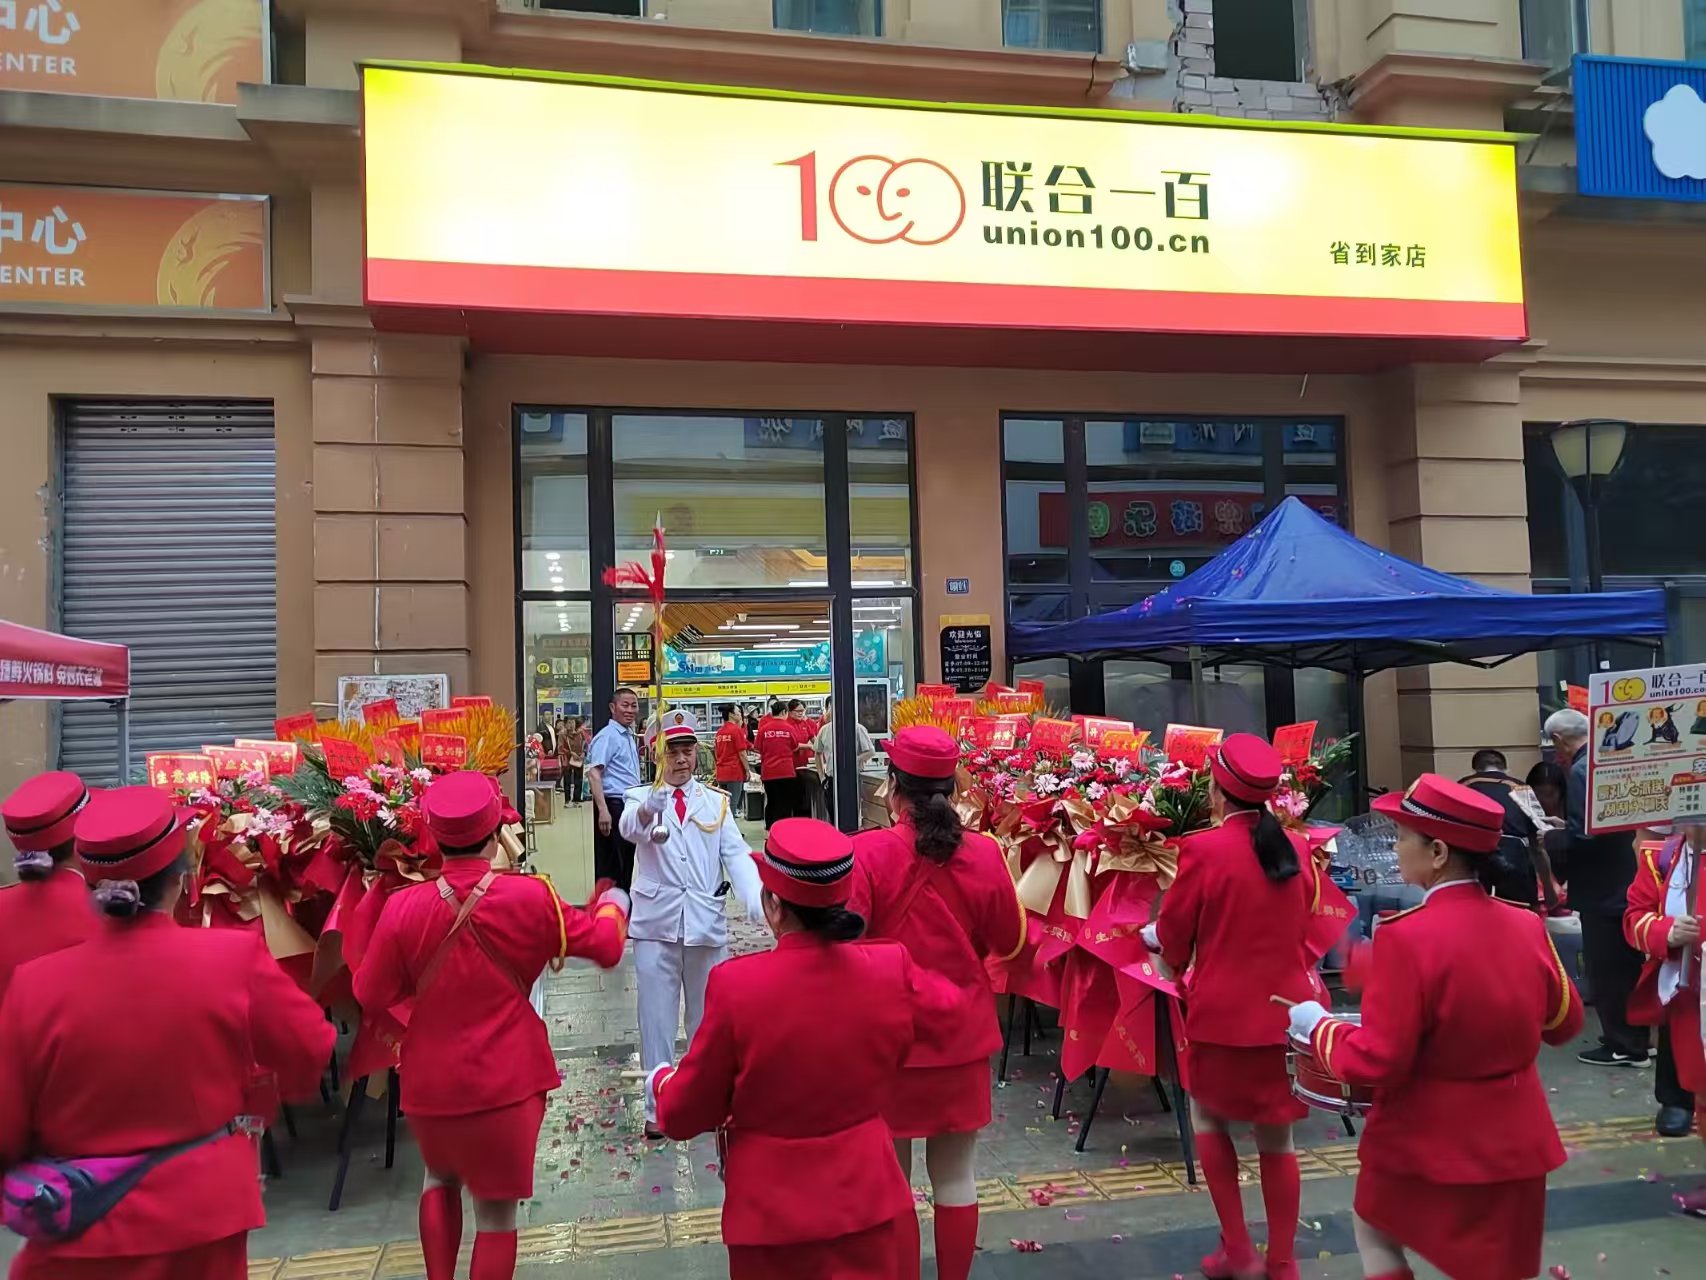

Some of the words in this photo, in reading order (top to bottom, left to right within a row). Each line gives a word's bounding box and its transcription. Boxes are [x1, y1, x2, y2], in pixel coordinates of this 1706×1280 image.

[0, 52, 77, 76] NTER
[980, 160, 1211, 220] 联合一百
[983, 221, 1210, 253] union100.cn
[1330, 241, 1426, 268] 省到家店
[0, 265, 86, 286] ENTER
[156, 769, 213, 785] 生意兴隆
